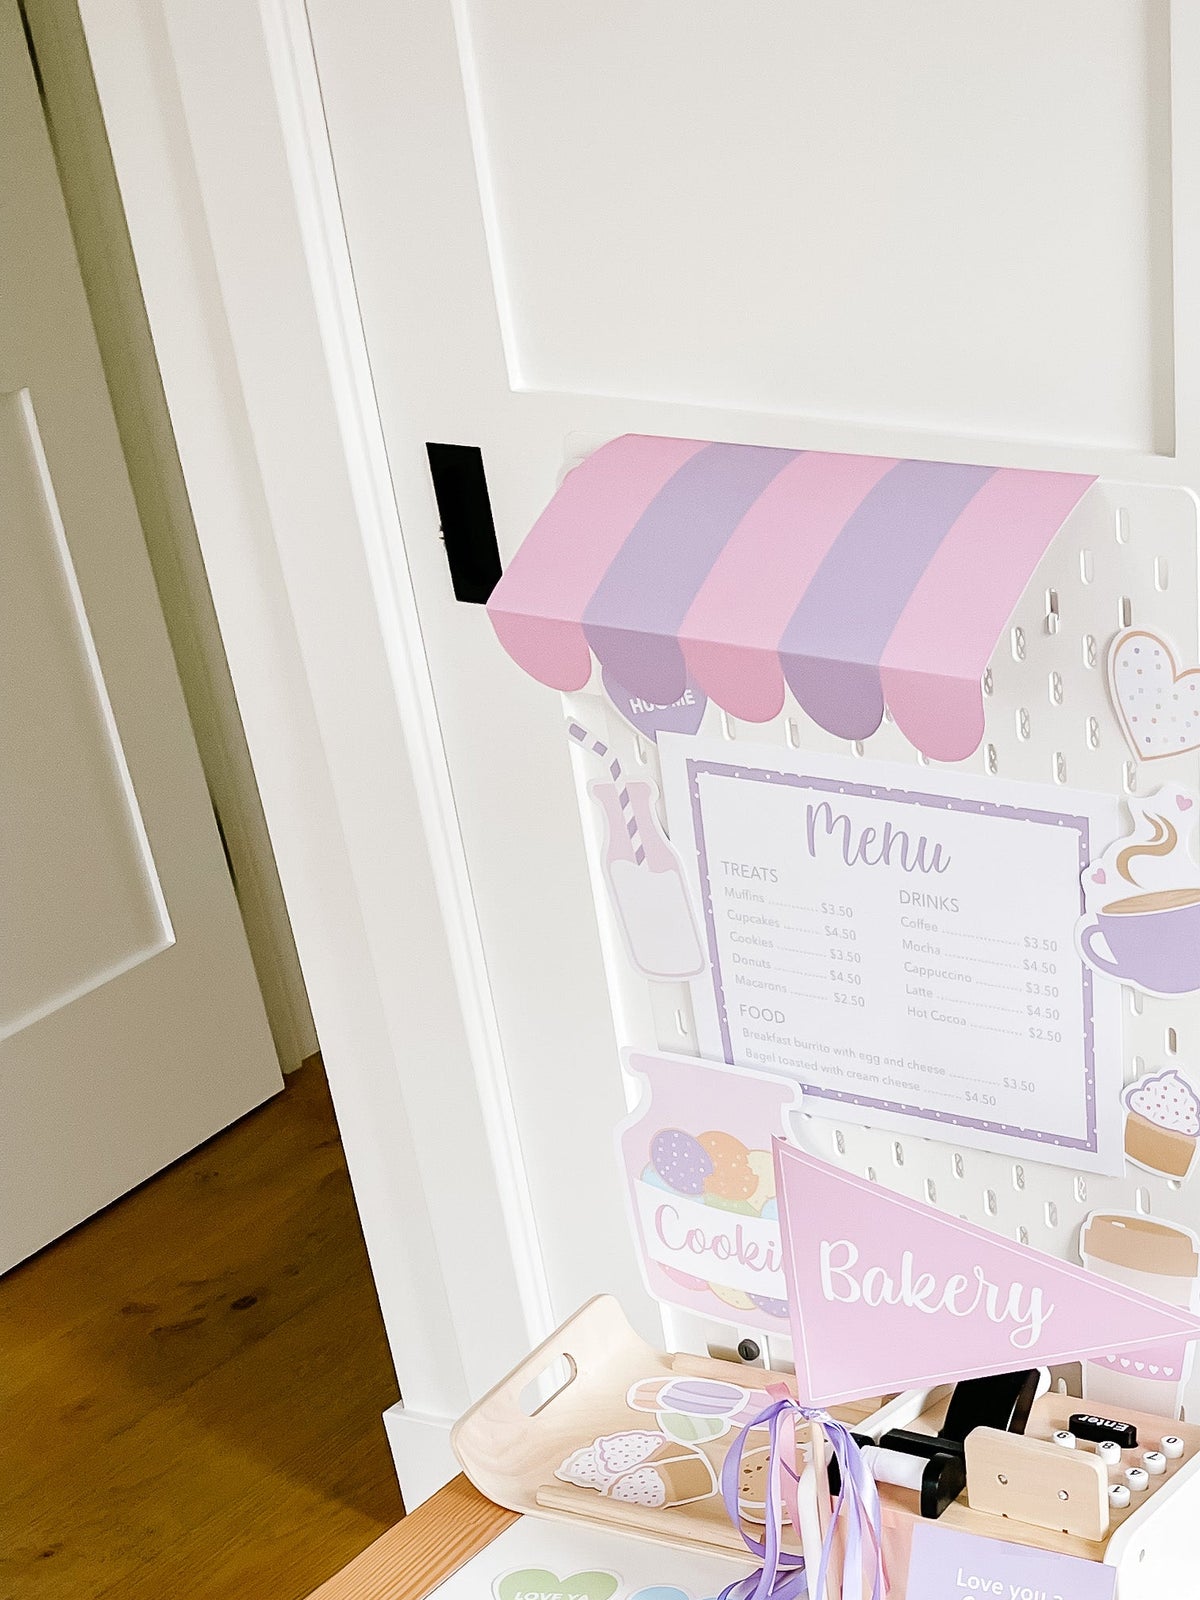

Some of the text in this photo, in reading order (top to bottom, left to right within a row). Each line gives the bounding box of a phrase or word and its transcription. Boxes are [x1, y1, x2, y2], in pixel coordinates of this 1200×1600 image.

[629, 697, 668, 714] HU
[805, 801, 952, 874] Menu
[721, 860, 778, 883] TREATS
[724, 887, 853, 918] Muffins $3.50
[899, 890, 960, 913] DRINKS
[727, 909, 856, 941] Cupcakes $4.50
[901, 916, 1058, 952] Coffee $3.50
[730, 931, 861, 963] Cookies $3.50
[902, 939, 1057, 975] Mocha $4.50
[732, 953, 861, 985] Donuts $4.50
[904, 961, 1059, 998] Cappuccino $3.50
[735, 974, 865, 1007] Macarons $2.50
[905, 984, 1060, 1021] Latte $4.50
[739, 1004, 785, 1024] FOOD
[907, 1006, 1062, 1043] Hot Cocoa $2.50
[742, 1028, 1036, 1093] Breakfast burrito with egg and cheese $3.50
[745, 1048, 997, 1107] Bagel toasted with cream cheese $4.50
[654, 1204, 782, 1272] Cooki
[819, 1239, 1055, 1349] Bakery
[1078, 1415, 1130, 1432] Enter
[956, 1567, 1004, 1595] Love
